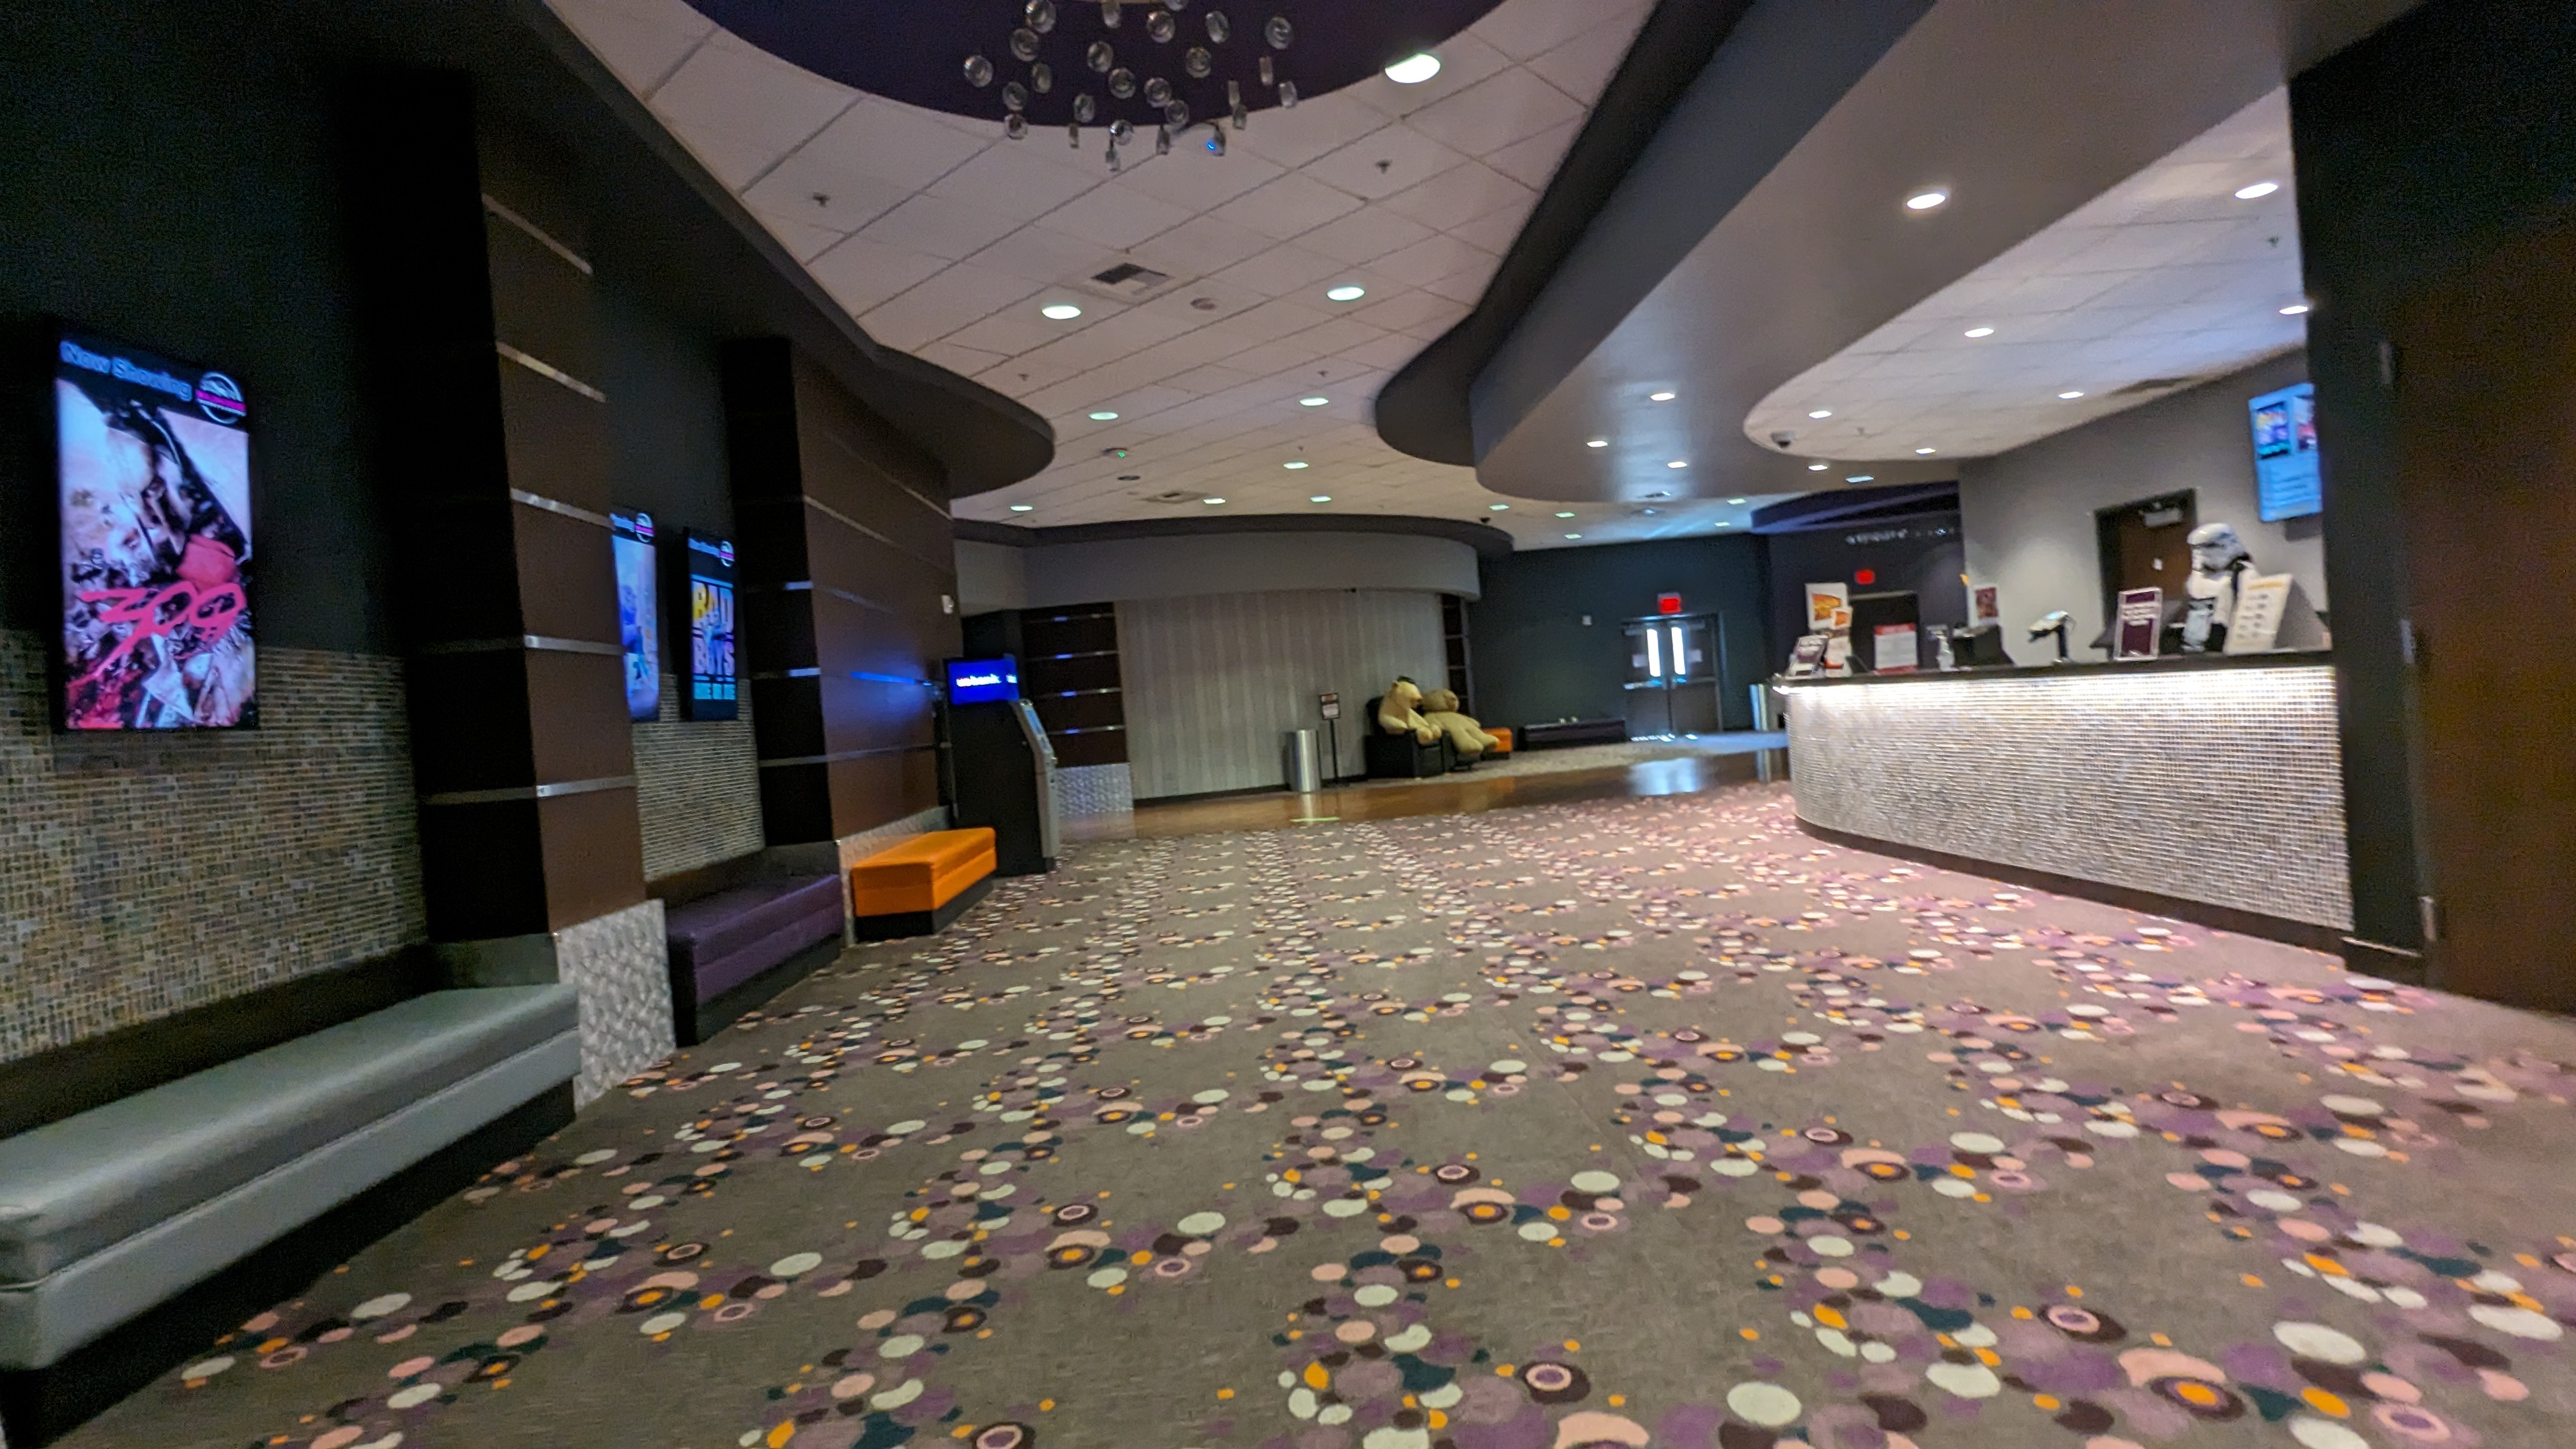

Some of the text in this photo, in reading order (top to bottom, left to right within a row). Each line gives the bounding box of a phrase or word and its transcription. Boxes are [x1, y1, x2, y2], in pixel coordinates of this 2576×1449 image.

[59, 341, 111, 374] Now
[111, 356, 193, 403] Showing
[81, 580, 247, 678] 300
